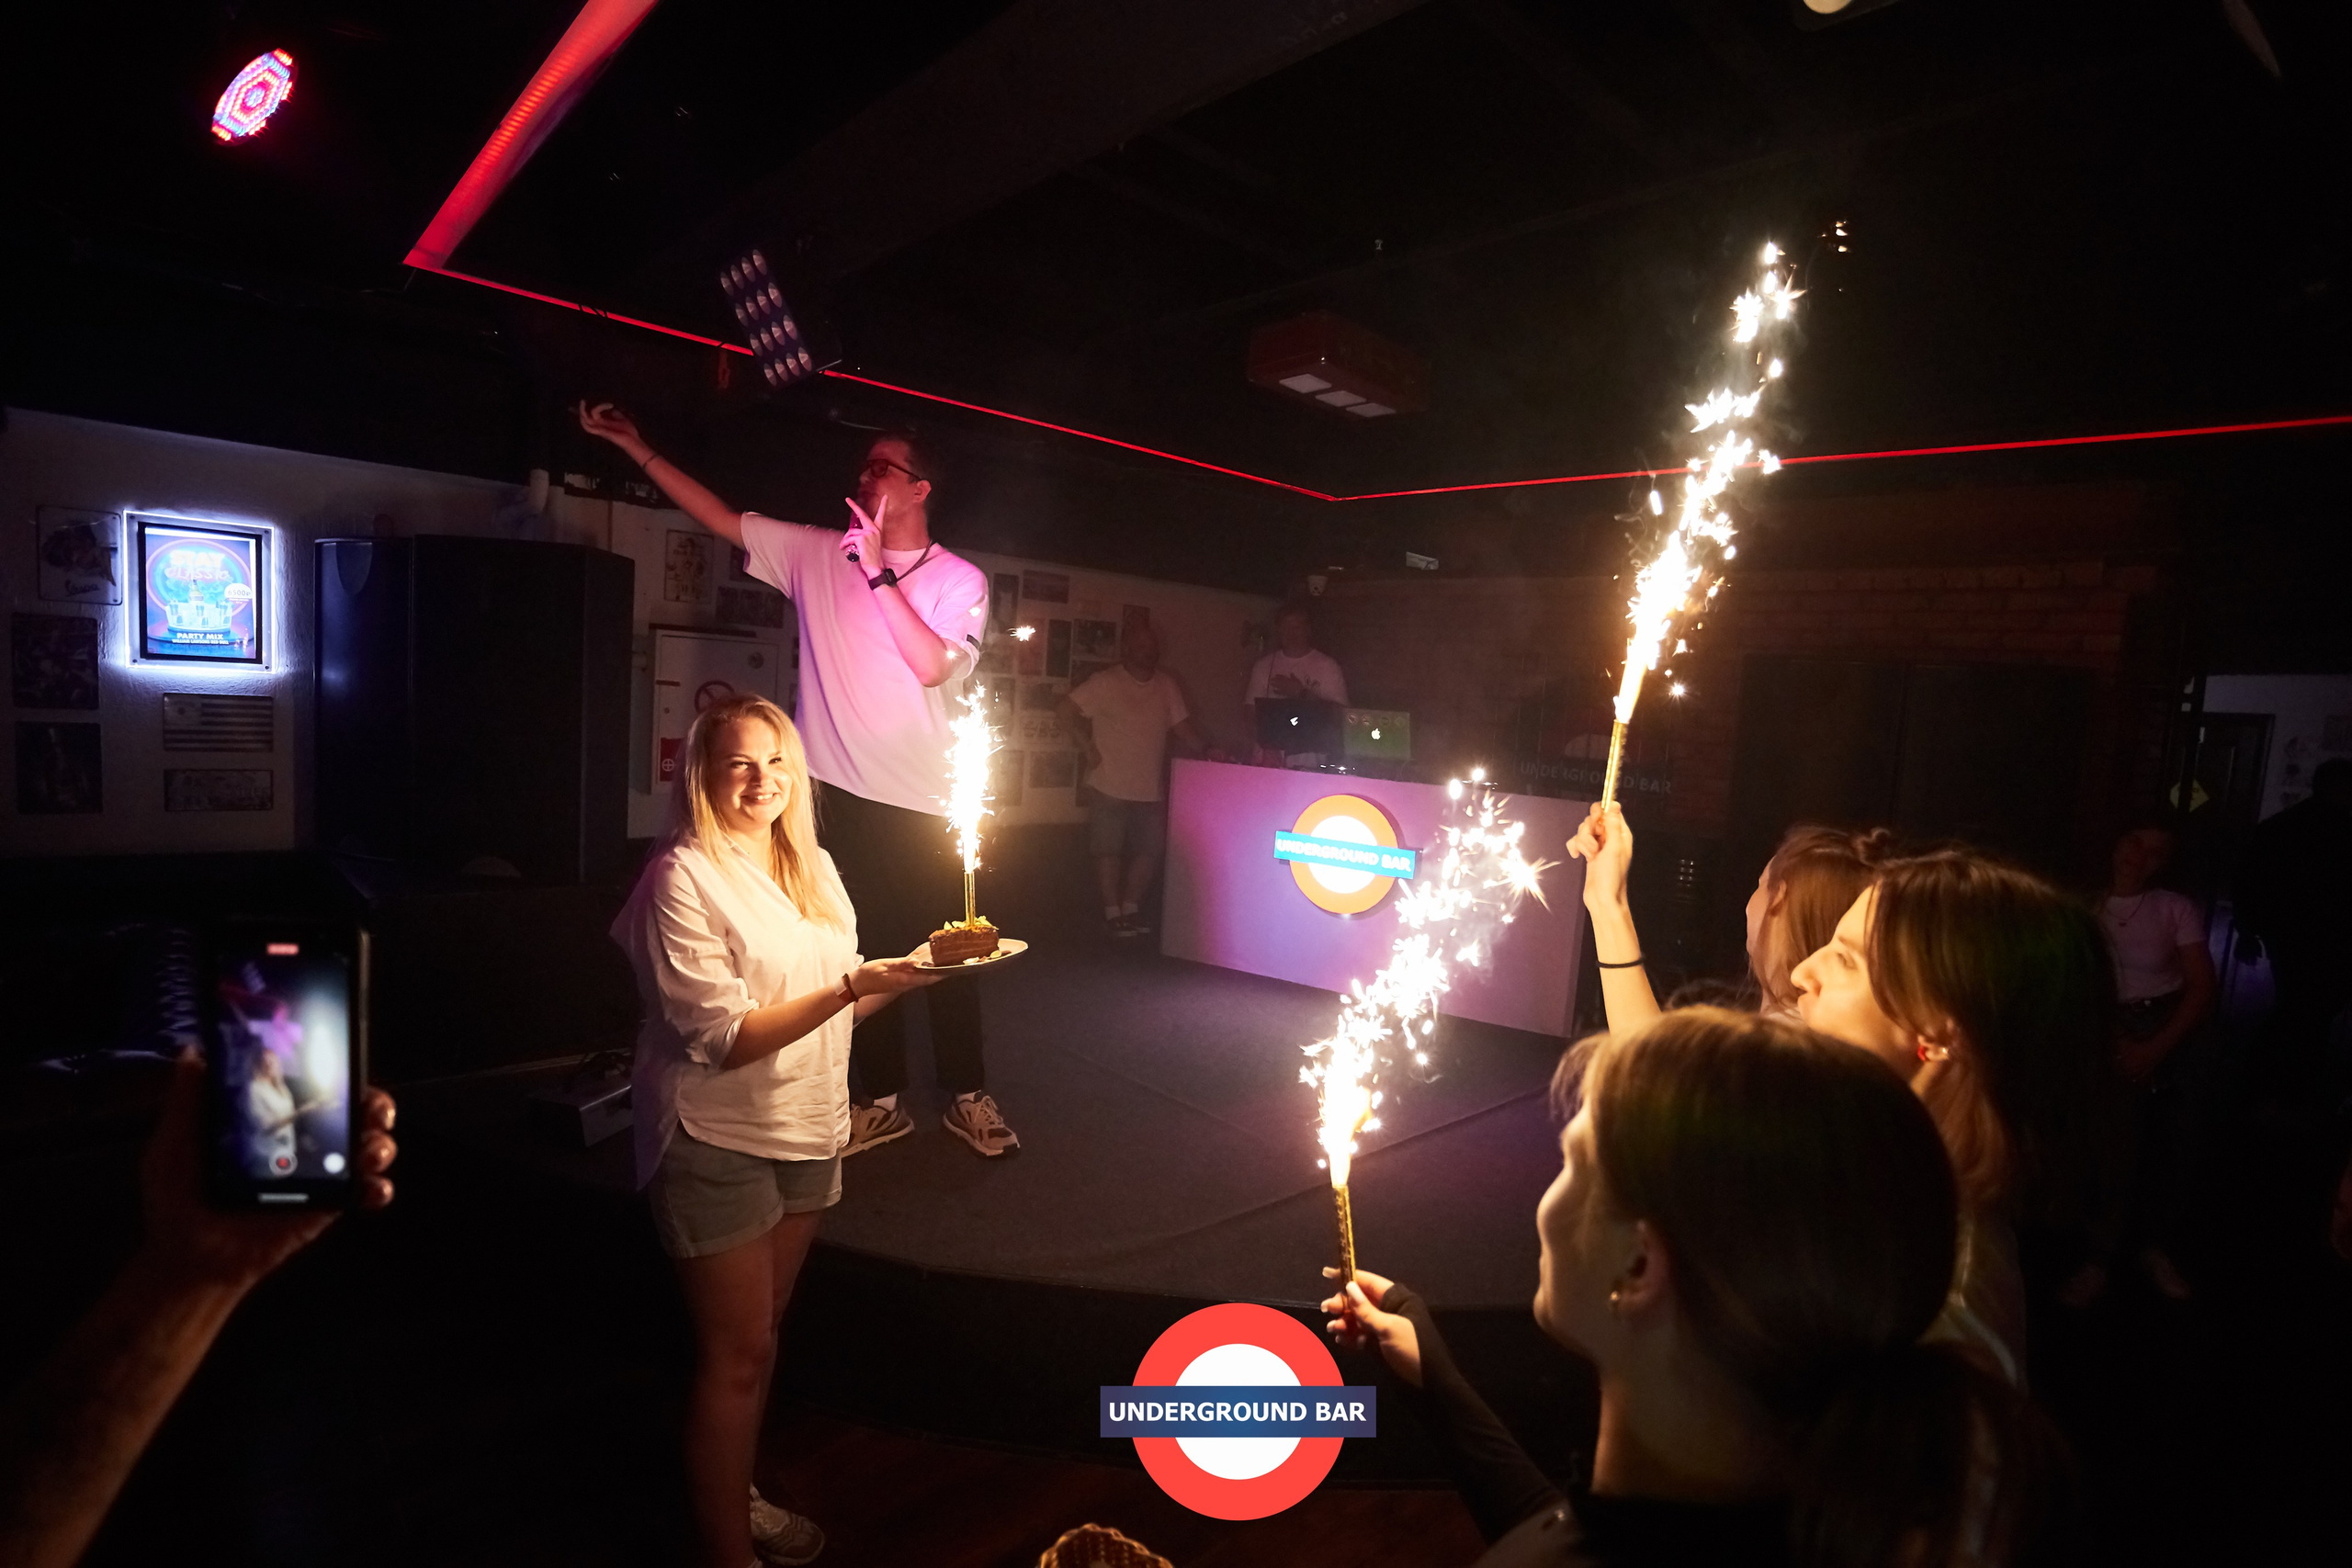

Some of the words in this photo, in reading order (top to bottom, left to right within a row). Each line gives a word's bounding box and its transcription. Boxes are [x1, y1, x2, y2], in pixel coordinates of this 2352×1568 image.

[169, 549, 225, 568] STAY
[1638, 777, 1672, 795] BAR
[1276, 838, 1379, 865] UNDERGROUND
[1381, 853, 1412, 872] BAR
